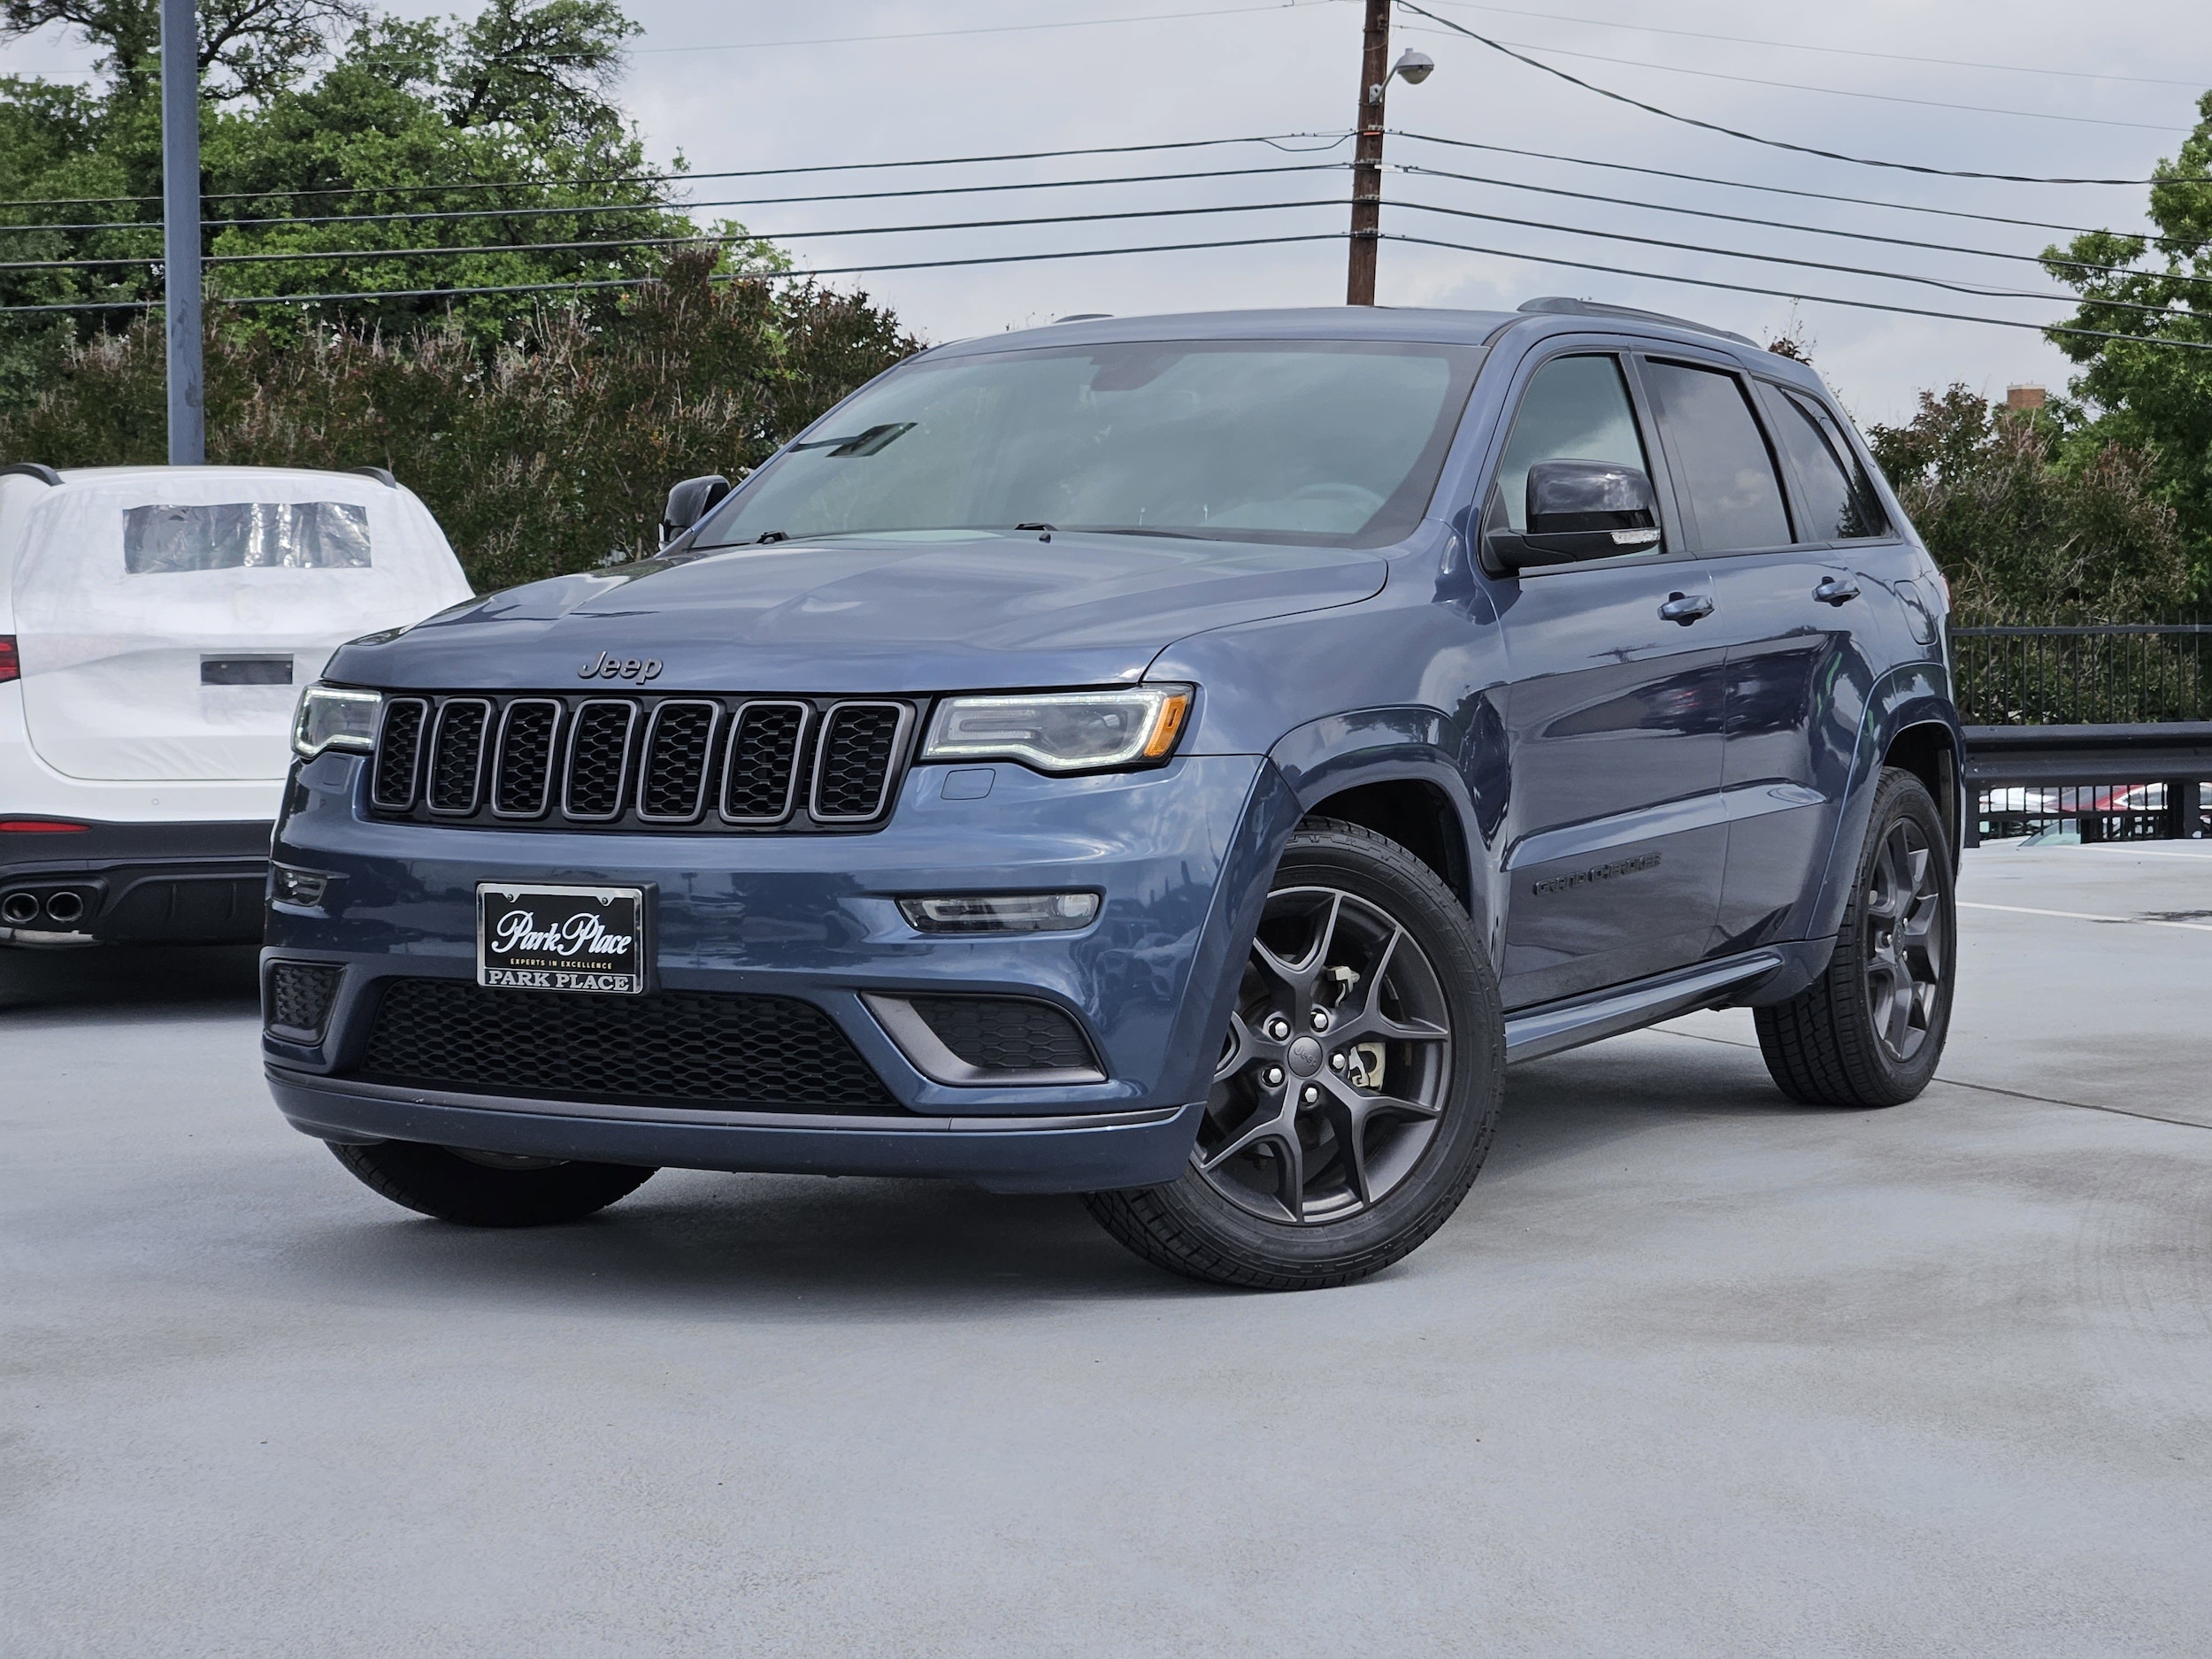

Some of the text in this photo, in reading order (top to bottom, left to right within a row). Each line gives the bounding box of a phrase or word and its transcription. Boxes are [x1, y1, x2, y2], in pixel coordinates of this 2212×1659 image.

[578, 650, 663, 685] Jeep
[1532, 871, 1586, 895] GRAND
[491, 910, 633, 956] Park Place
[510, 957, 546, 966] EXPERTS
[561, 960, 612, 970] EXCELLENCE
[488, 970, 630, 991] PARK PLACE
[1294, 1046, 1318, 1068] Jeep
